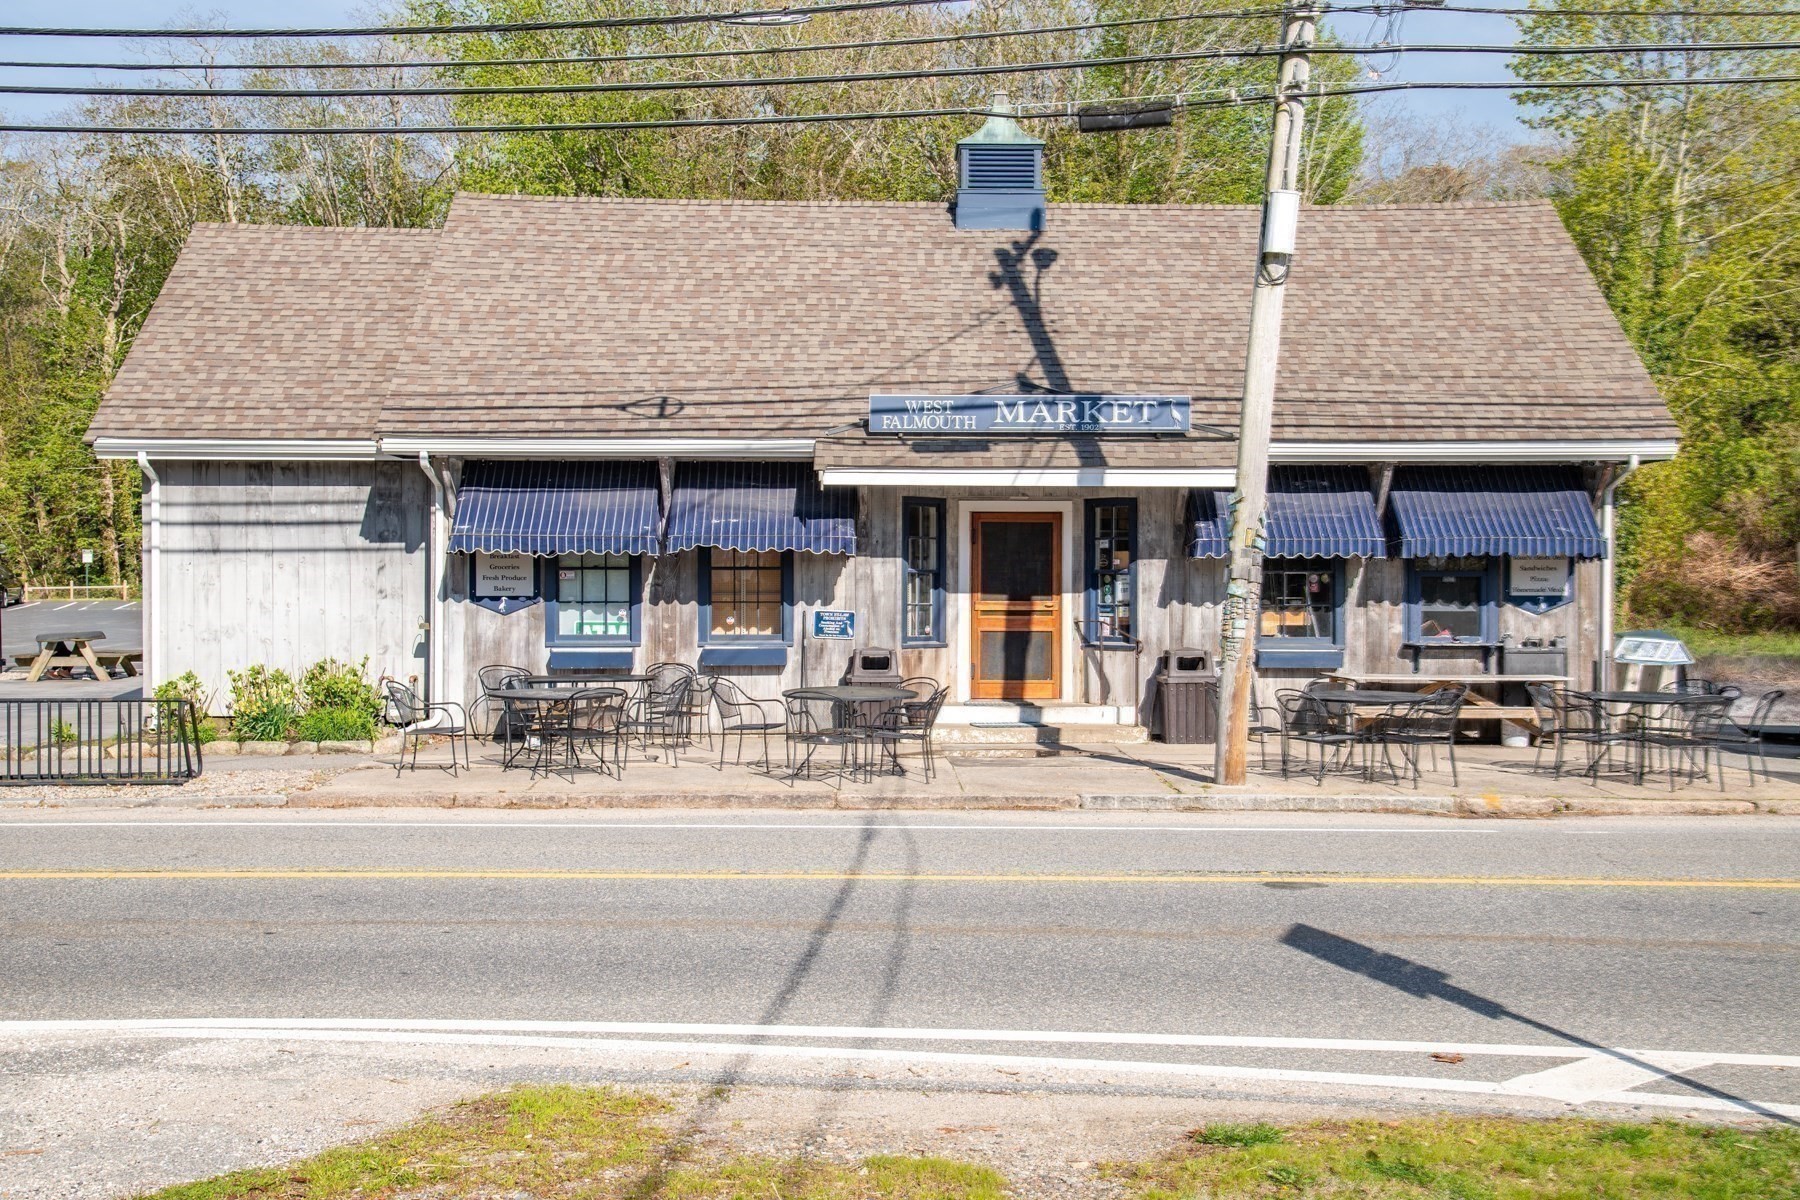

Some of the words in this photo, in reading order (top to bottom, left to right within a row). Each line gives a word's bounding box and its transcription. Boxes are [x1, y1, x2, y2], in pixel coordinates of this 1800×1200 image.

[904, 399, 954, 414] WEST
[993, 400, 1158, 423] MARKET
[881, 415, 977, 429] FALMOUTH
[579, 624, 627, 635] ATM
